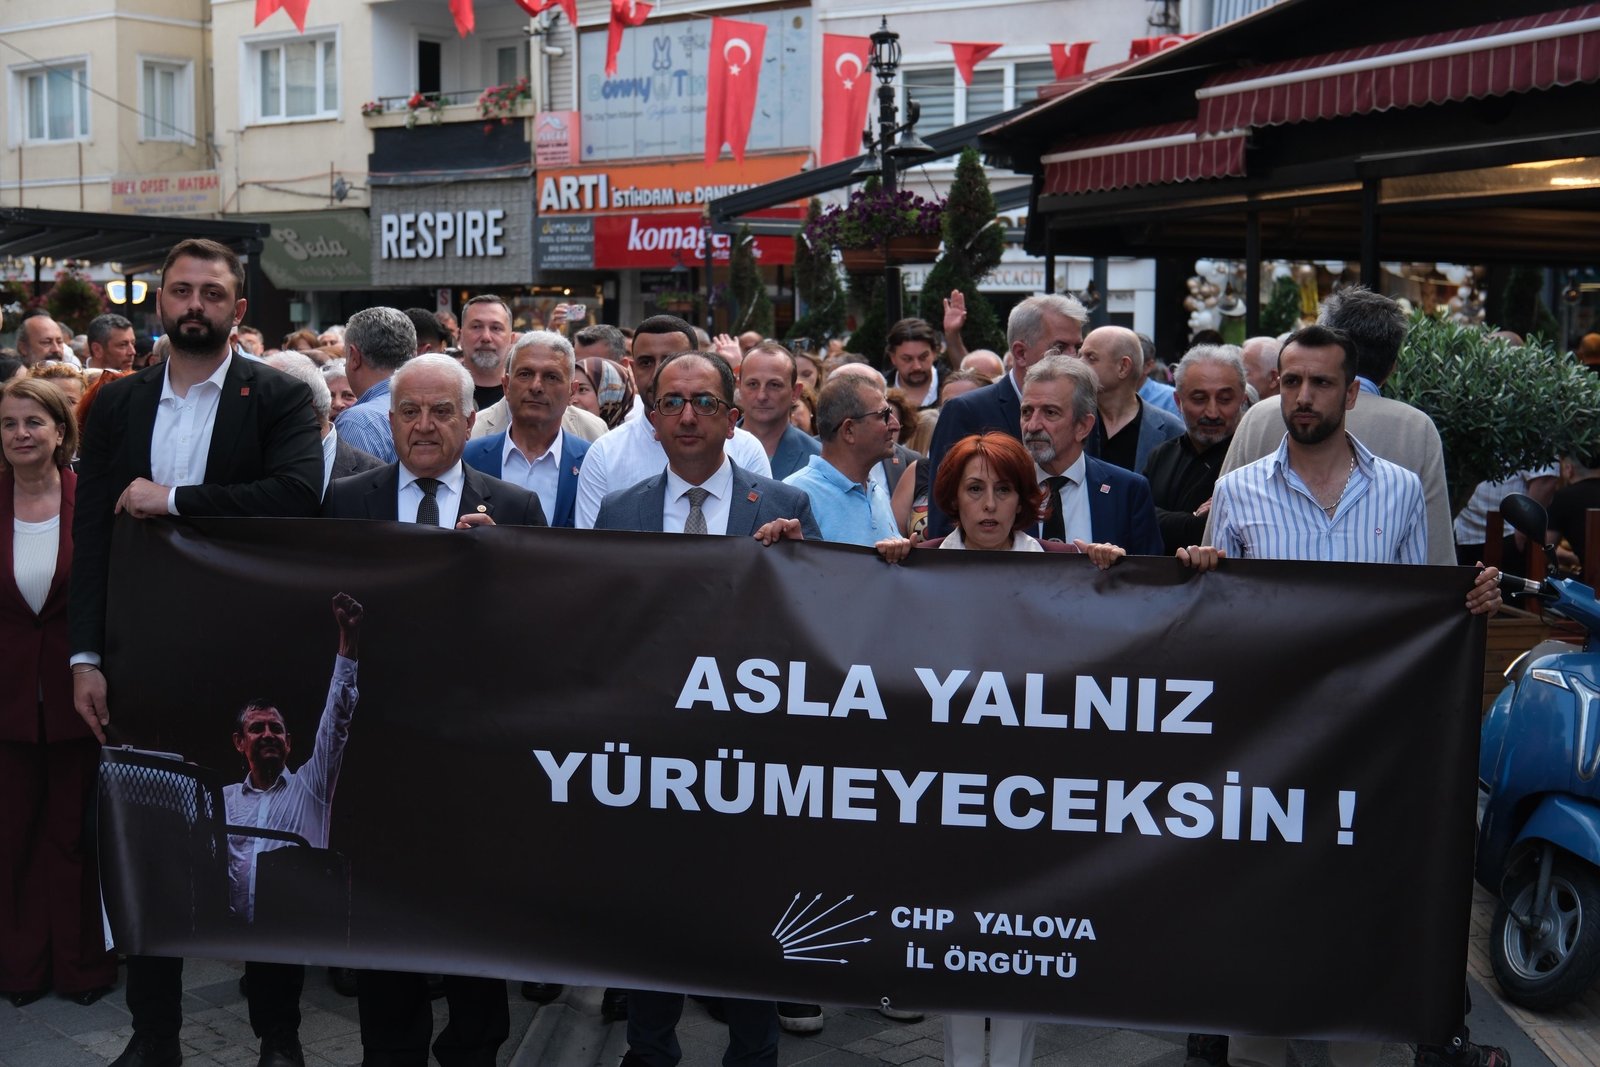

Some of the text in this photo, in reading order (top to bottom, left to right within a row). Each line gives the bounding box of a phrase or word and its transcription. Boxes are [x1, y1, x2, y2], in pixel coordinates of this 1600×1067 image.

[540, 174, 608, 211] ARTI
[677, 191, 692, 204] ve
[381, 209, 504, 259] RESPIRE
[674, 656, 1214, 734] ASLA YALNIZ
[532, 742, 1356, 845] YÜRÜMEYECEKSİN !
[890, 906, 1097, 941] CHP YALOVA
[905, 941, 1078, 979] İL ÖRGÜTÜ
